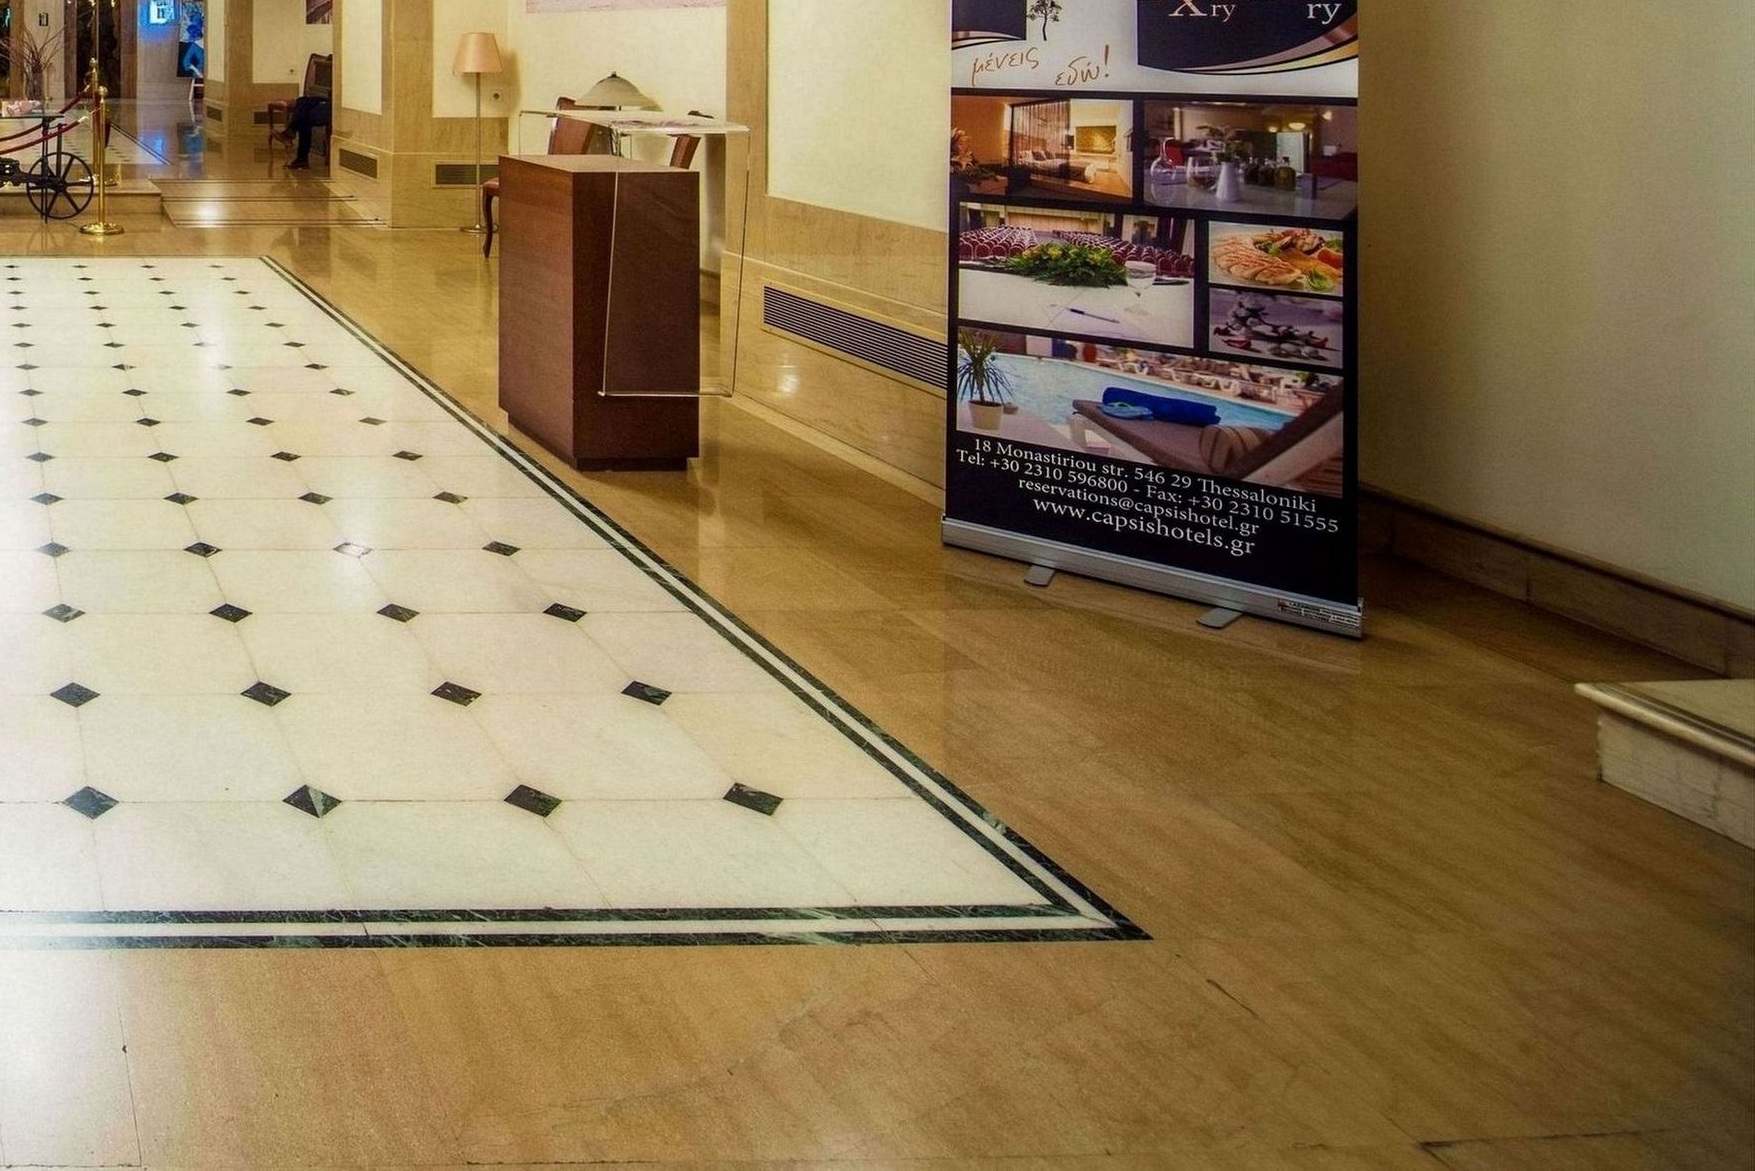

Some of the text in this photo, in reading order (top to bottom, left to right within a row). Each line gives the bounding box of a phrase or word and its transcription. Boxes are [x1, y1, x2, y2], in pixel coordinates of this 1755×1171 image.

[956, 448, 985, 467] Tel:
[990, 457, 1020, 473] +30
[1024, 462, 1063, 480] 2310
[1067, 471, 1128, 493] 596800
[1146, 485, 1182, 504] Fax:
[1188, 495, 1223, 511] +30
[1229, 500, 1274, 521] 2310
[1280, 510, 1339, 533] 51555
[975, 438, 1317, 513] 18 Monastiriou str. 546 29 Thessaloniki
[1018, 479, 1260, 537] reservations@capsishotel.gr
[1033, 498, 1256, 557] www.capsishotels.gr
